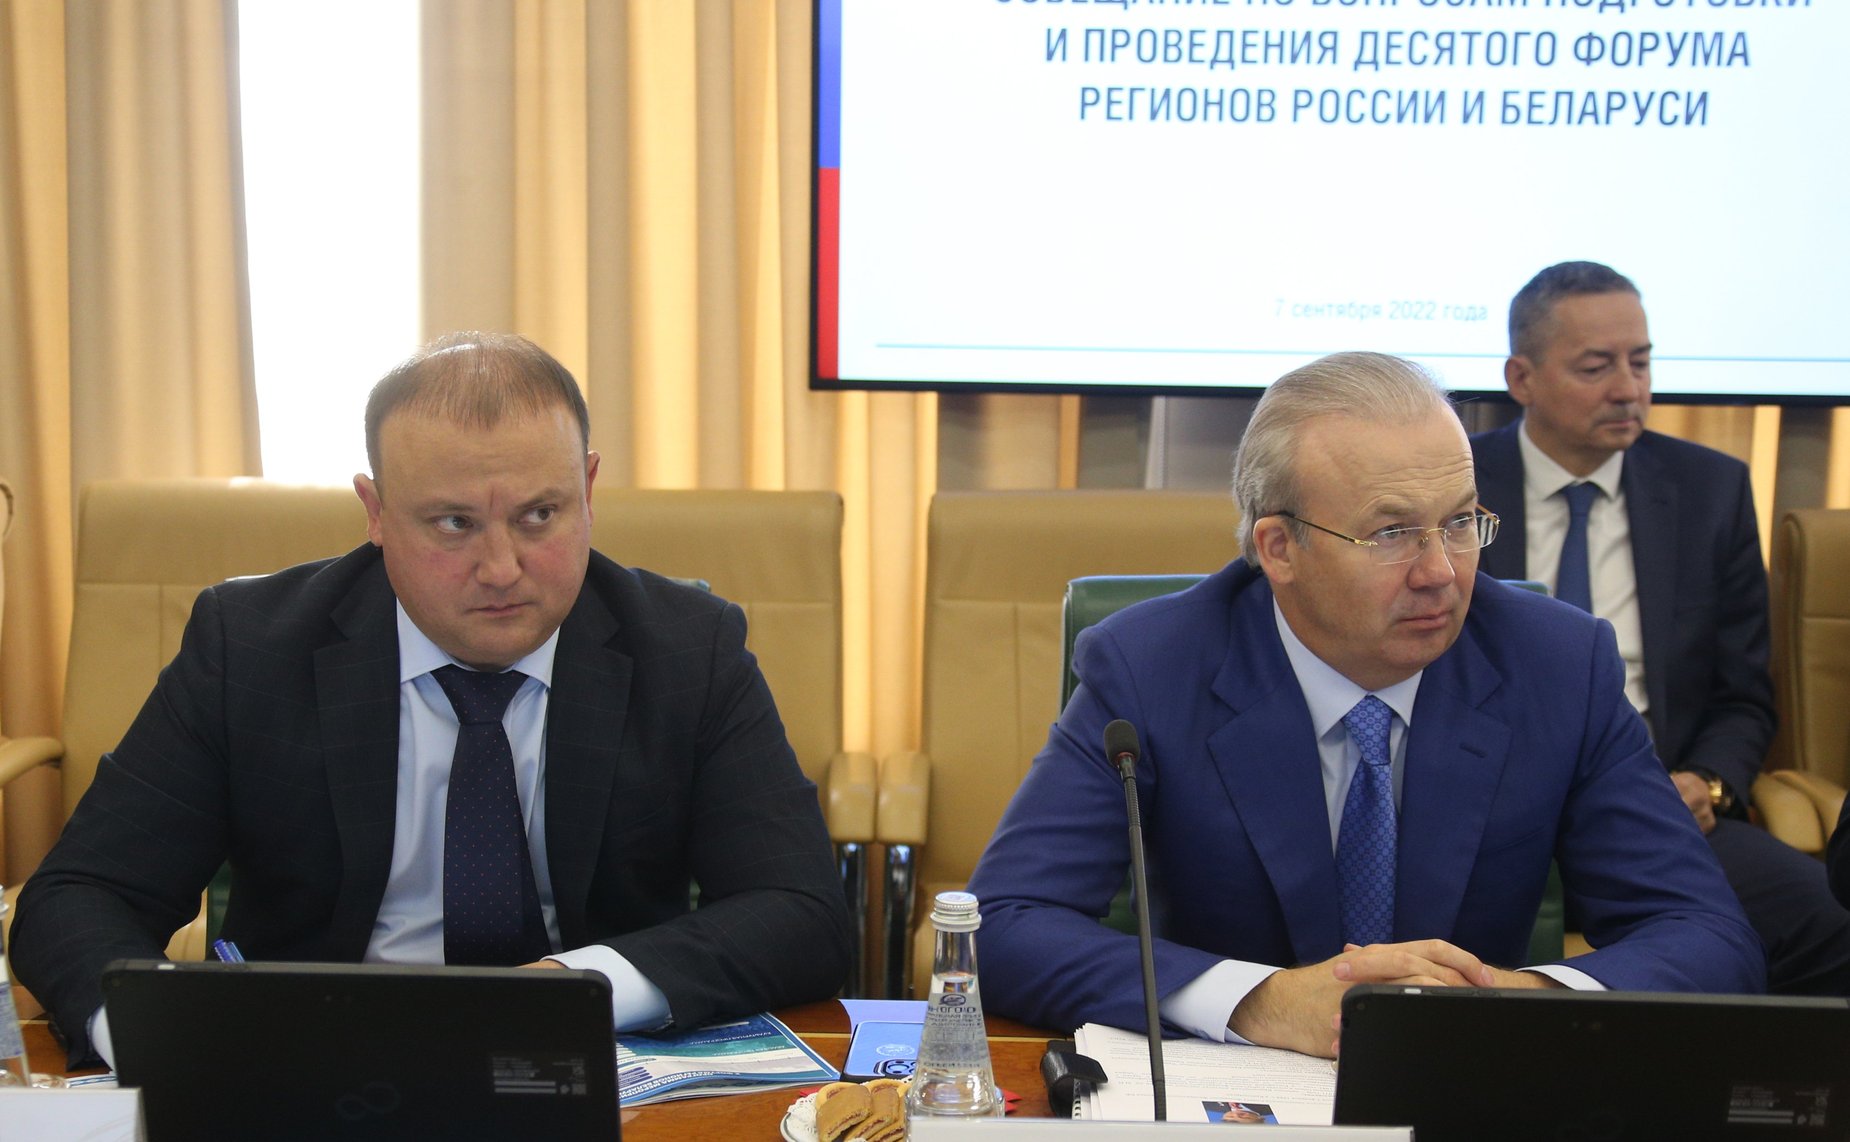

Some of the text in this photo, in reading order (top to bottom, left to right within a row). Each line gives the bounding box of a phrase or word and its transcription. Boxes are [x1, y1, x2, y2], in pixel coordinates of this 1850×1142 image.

[1045, 27, 1751, 72] И ПРОВЕДЕНИЯ ДЕСЯТОГО ФОРУМА
[1080, 86, 1710, 126] РЕГИОНОВ РОССИИ И БЕЛАРУСИ
[1275, 298, 1489, 322] 7 сентября 2022 года
